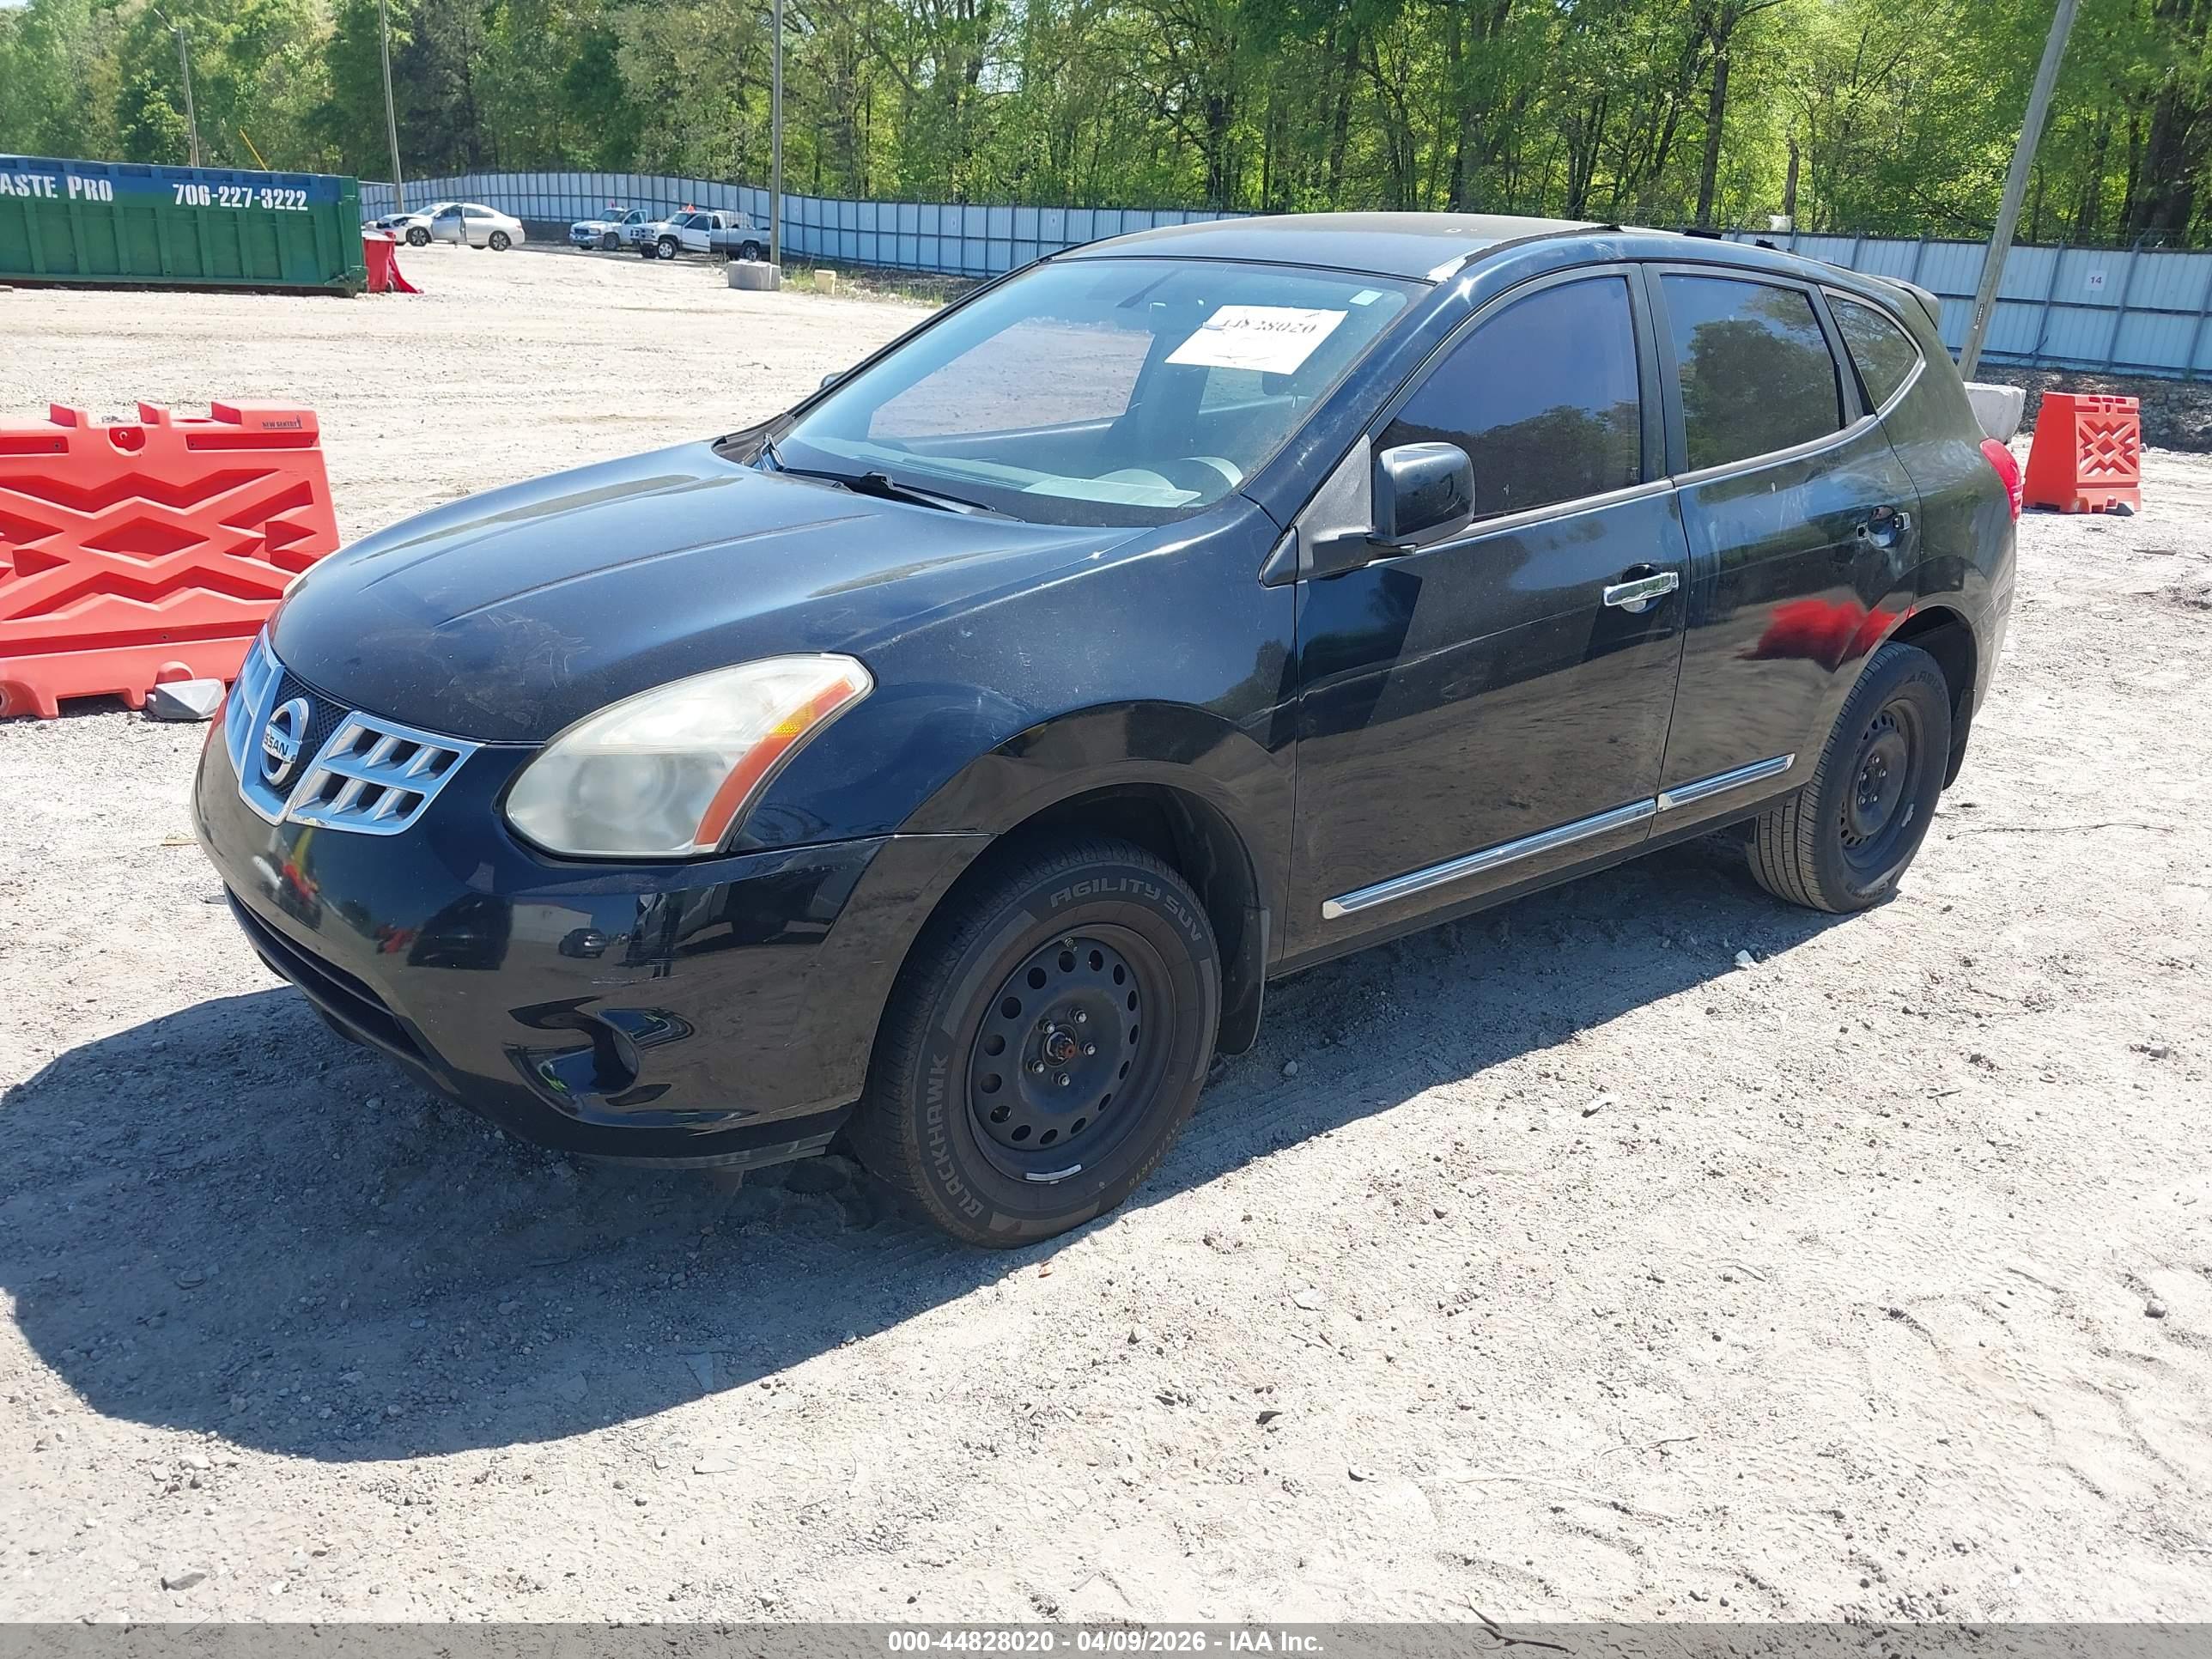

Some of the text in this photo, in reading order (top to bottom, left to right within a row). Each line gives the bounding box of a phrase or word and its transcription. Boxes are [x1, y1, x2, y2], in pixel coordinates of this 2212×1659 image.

[67, 175, 113, 202] PRO
[173, 184, 308, 211] 706-227-3222
[1050, 878, 1201, 941] AGILITY SUV
[927, 1054, 984, 1218] BLACKHAWK
